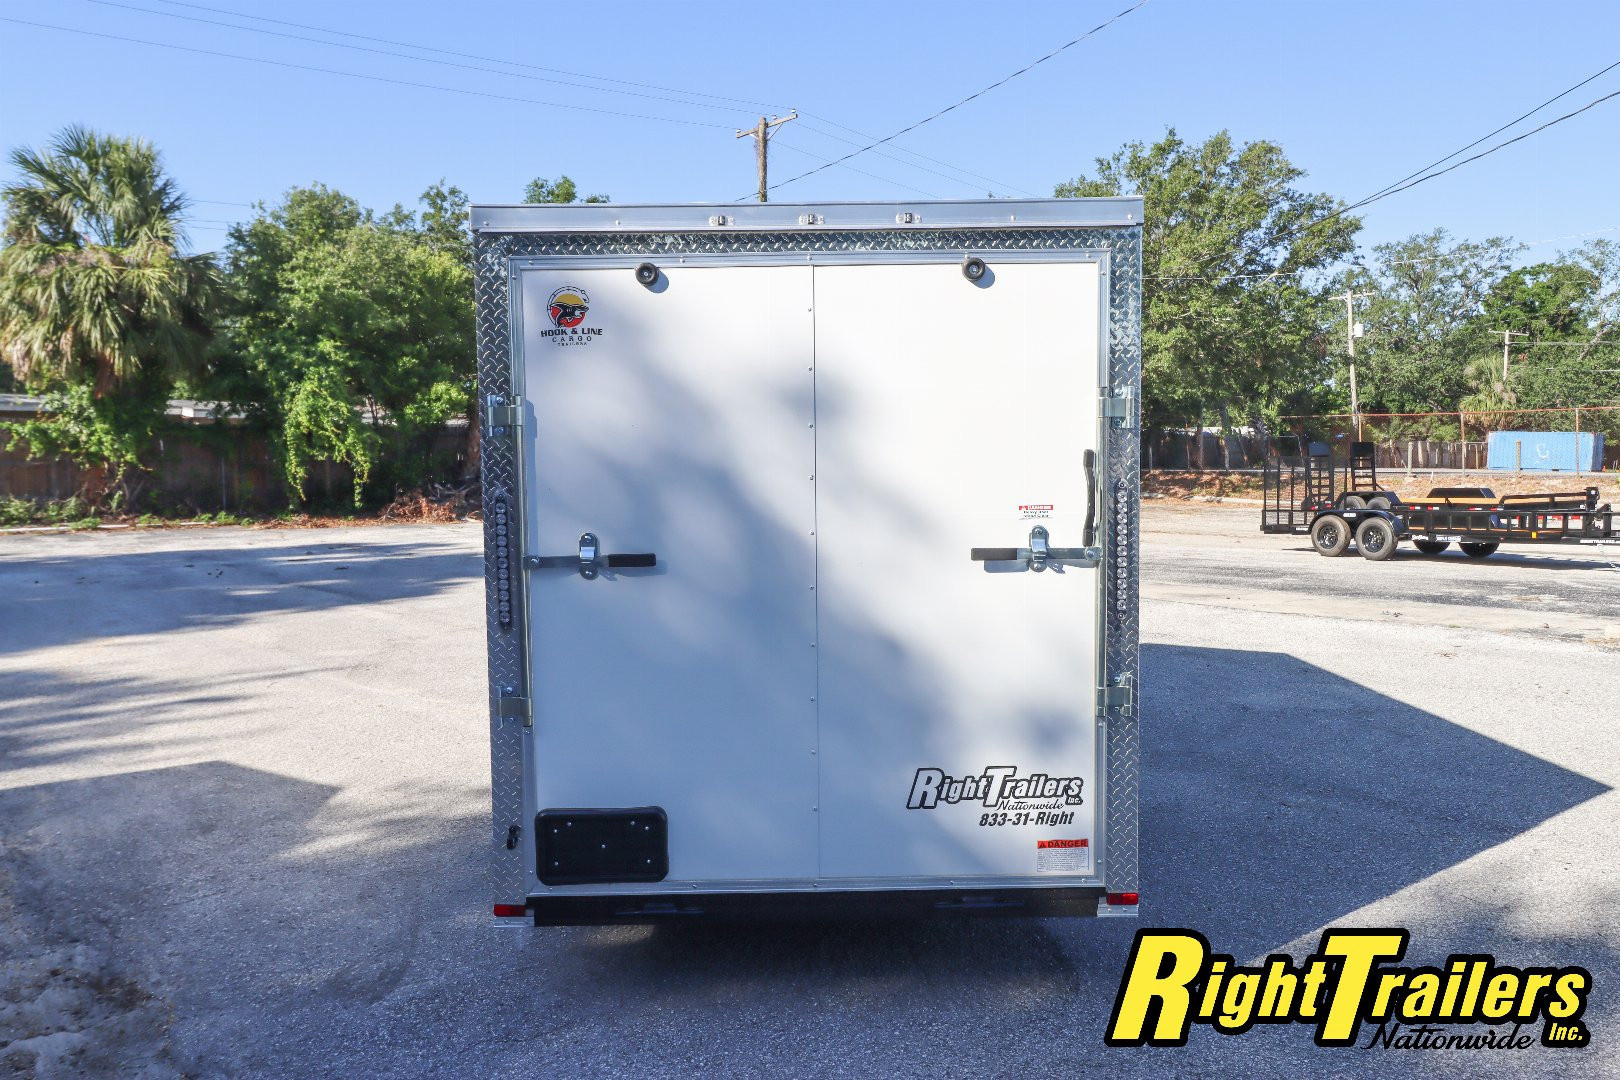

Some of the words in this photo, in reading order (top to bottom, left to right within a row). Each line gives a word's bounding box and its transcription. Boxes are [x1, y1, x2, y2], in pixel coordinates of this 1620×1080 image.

[541, 328, 568, 337] HOOK
[582, 327, 603, 336] LINE
[552, 335, 592, 343] CARGO
[997, 798, 1064, 811] Nationwide
[979, 811, 1075, 827] 833-31-Right
[1048, 839, 1088, 848] DANGER
